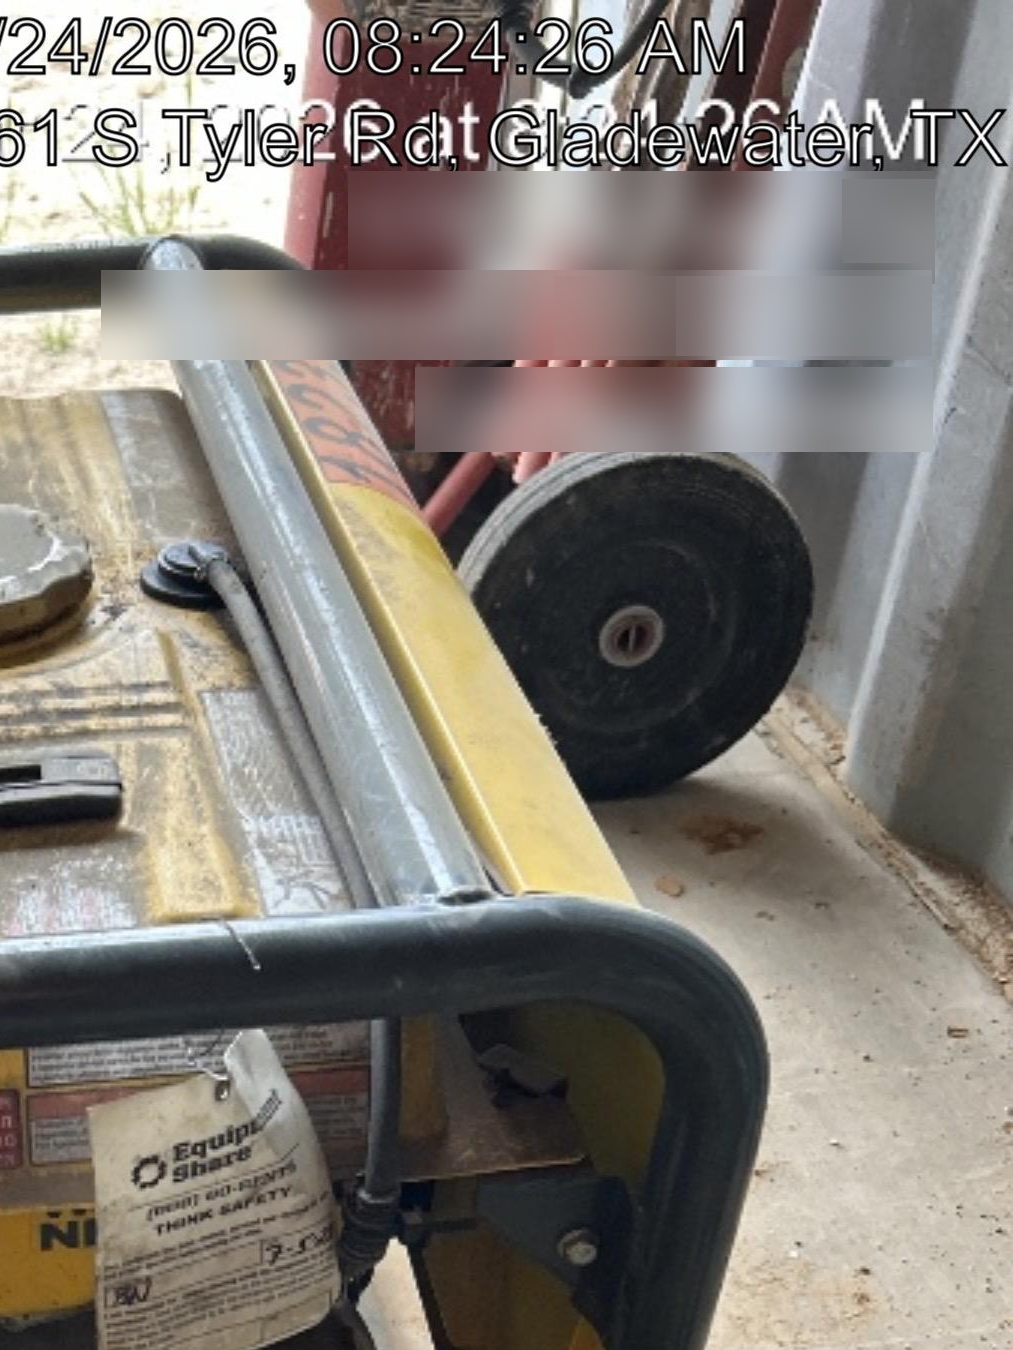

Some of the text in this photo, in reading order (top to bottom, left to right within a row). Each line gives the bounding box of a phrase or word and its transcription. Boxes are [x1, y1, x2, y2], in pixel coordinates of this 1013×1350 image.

[172, 1146, 252, 1184] Share
[155, 1186, 292, 1237] THINK SAFETY
